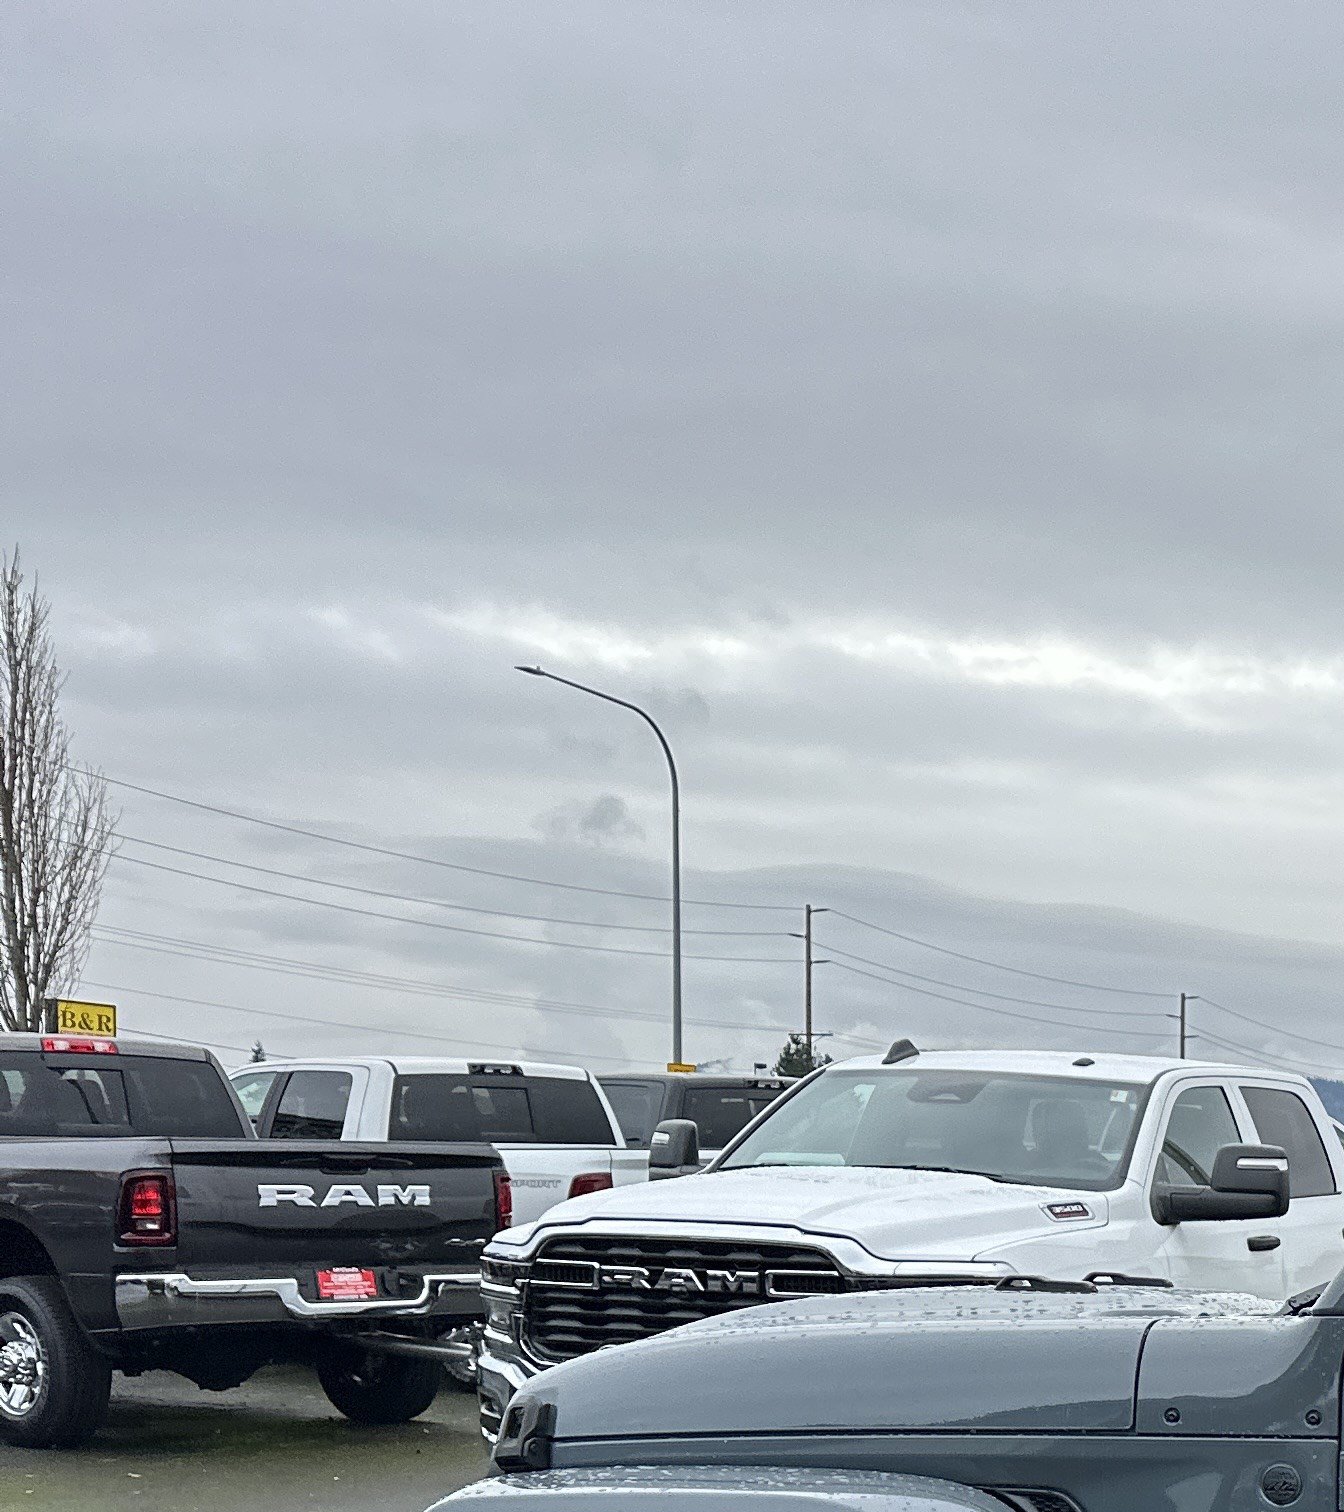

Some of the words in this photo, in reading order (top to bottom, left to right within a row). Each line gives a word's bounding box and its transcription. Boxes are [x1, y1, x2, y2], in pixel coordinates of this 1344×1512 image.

[60, 1010, 112, 1032] B&R
[257, 1184, 431, 1208] RAM
[600, 1264, 760, 1293] RAM
